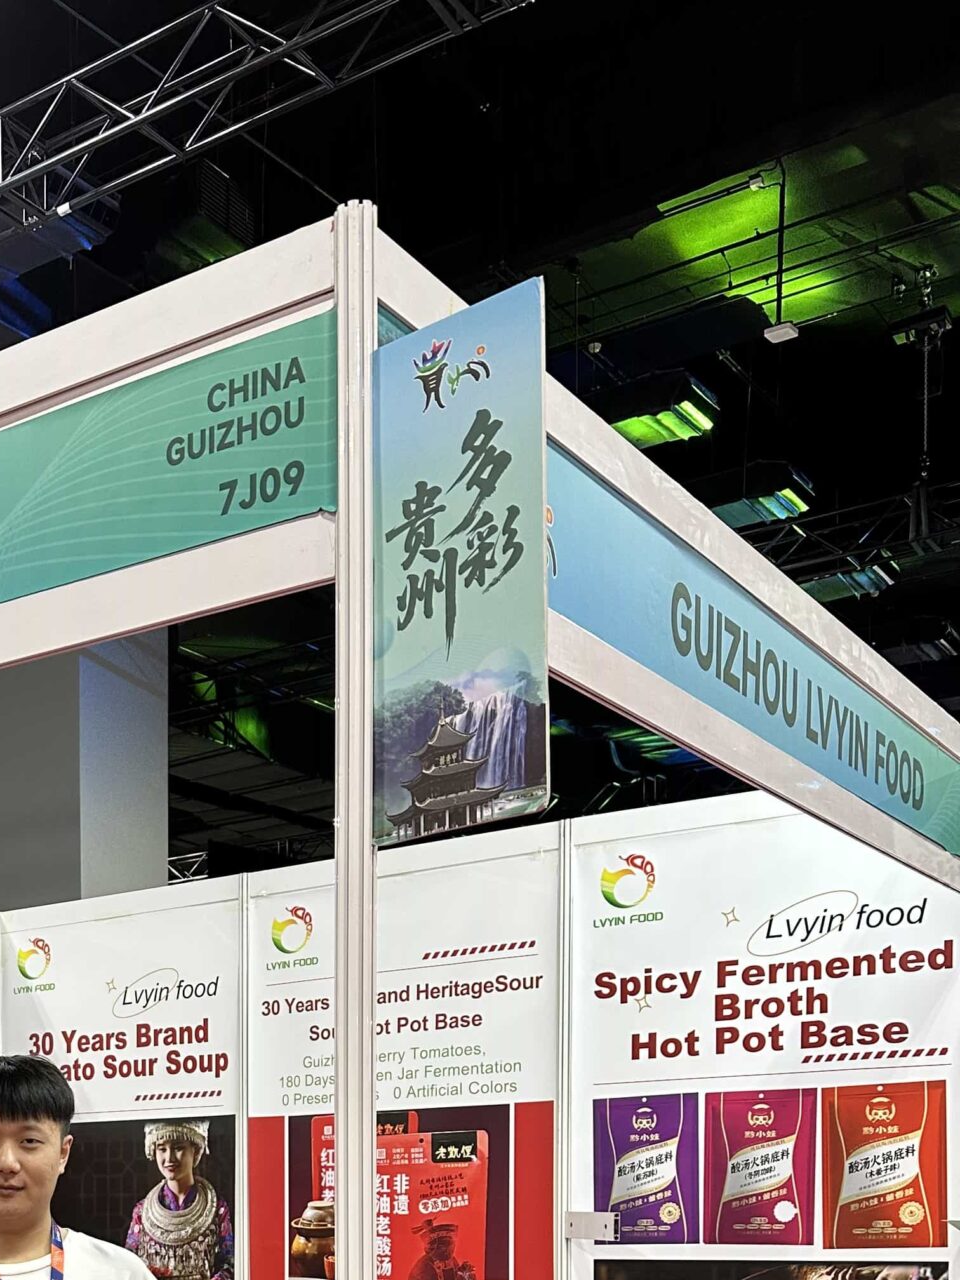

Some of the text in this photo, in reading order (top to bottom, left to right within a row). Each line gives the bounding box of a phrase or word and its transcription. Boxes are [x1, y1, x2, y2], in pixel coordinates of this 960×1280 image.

[207, 356, 306, 412] CHINA
[166, 396, 305, 466] GUIZHOU
[219, 460, 305, 516] 7J09
[437, 408, 524, 594] 多彩
[671, 582, 924, 811] GUIZHOU LVYIN FOOD
[593, 911, 663, 928] LVYIN FOOD
[765, 898, 928, 942] Lvyin food
[266, 956, 318, 971] LVYIN FOOD
[594, 939, 953, 1004] Spicy Fermented
[13, 983, 55, 995] LVYIN FOOD
[122, 976, 219, 1008] Lvyin food
[261, 973, 543, 1016] 30 Years and HeritageSour
[715, 987, 828, 1021] Broth
[29, 1018, 209, 1056] 30 Years Brand
[397, 1016, 429, 1034] Pot
[435, 1010, 483, 1030] Base
[631, 1020, 909, 1061] Hot Pot Base
[103, 1049, 229, 1079] Sour Soup
[279, 1076, 301, 1089] 180
[304, 1073, 335, 1091] Days
[397, 1066, 419, 1081] Jar
[424, 1060, 522, 1079] Fermentation
[281, 1080, 518, 1106] 0 0 Artificial Colors
[617, 1151, 673, 1177] 酸汤火锅底料
[730, 1148, 790, 1174] 酸汤火锅底料
[848, 1144, 916, 1174] 酸汤火锅底料
[393, 1174, 409, 1214] 非遗
